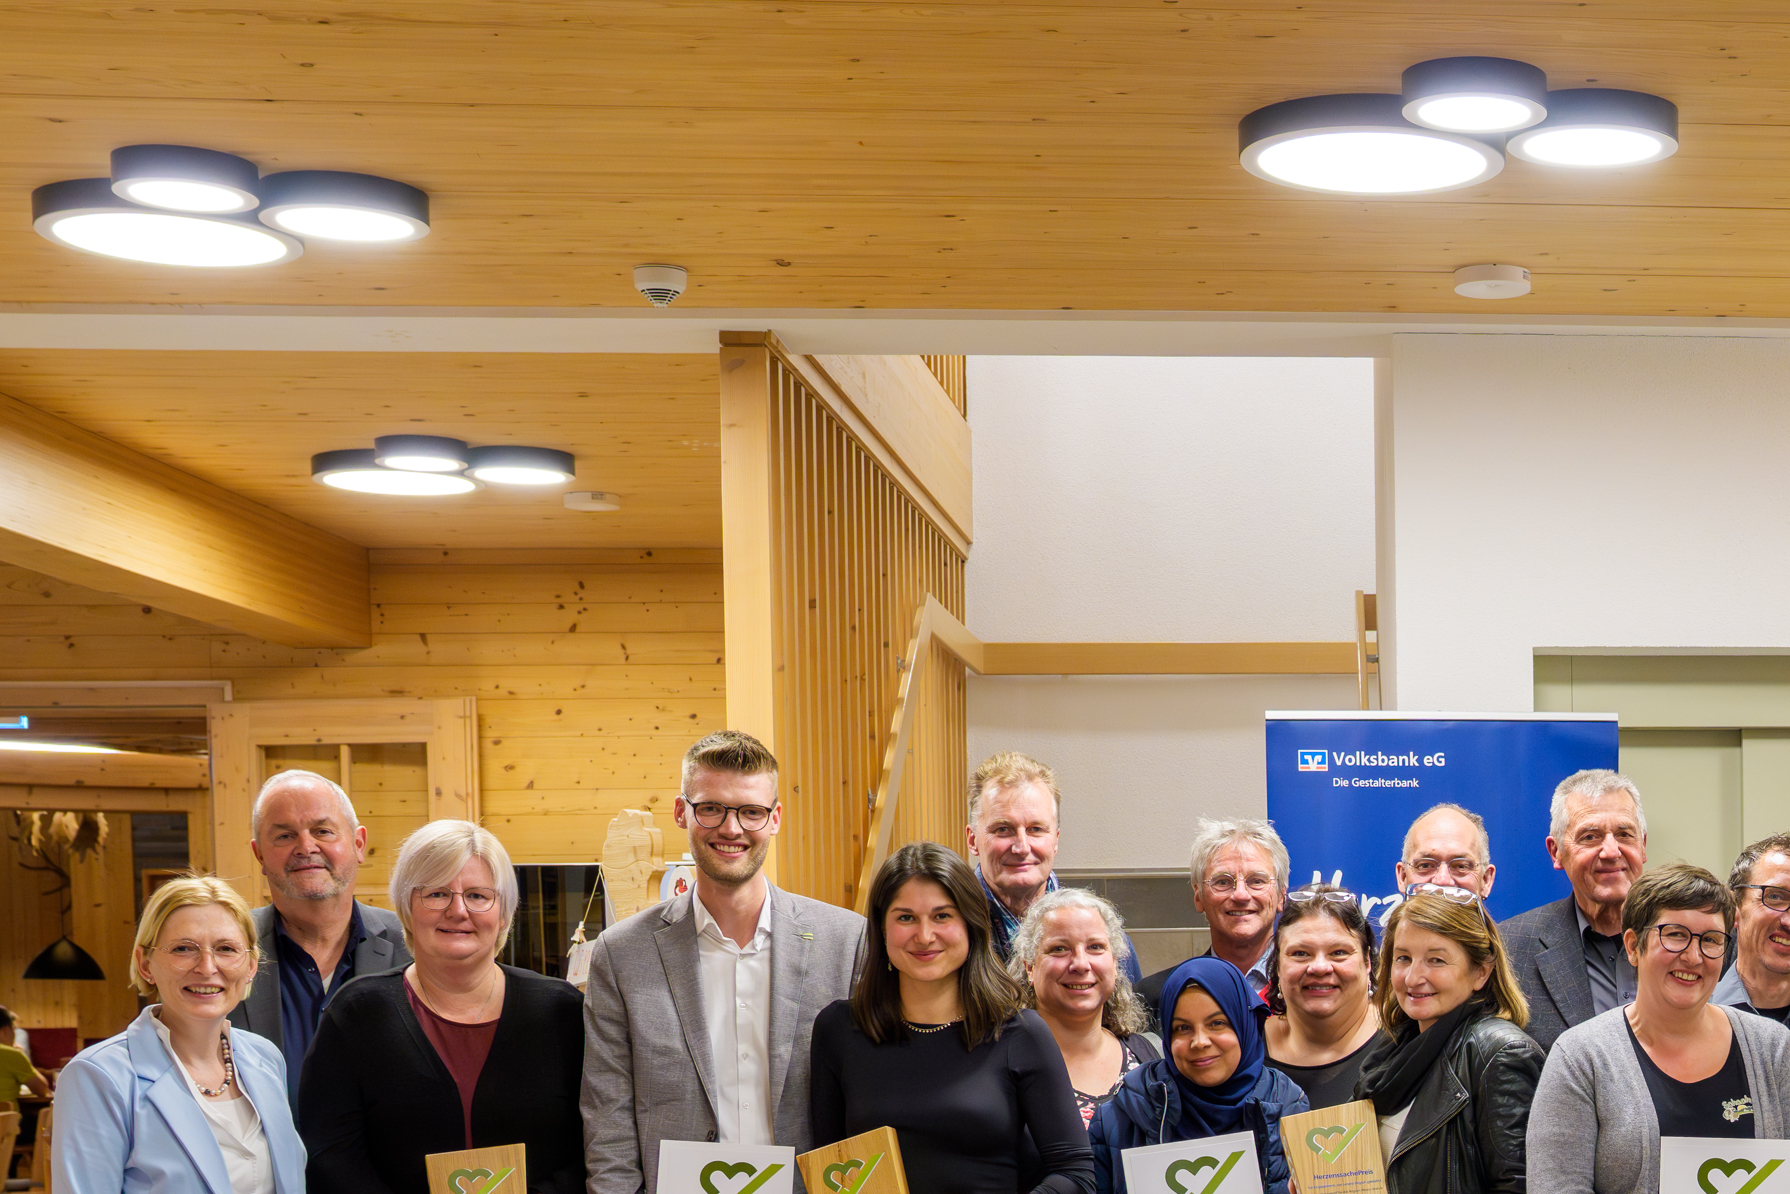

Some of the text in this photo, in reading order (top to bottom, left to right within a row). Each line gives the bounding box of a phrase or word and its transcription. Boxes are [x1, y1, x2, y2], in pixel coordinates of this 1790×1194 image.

[1332, 751, 1446, 767] Volksbank eG
[1332, 777, 1419, 788] Die Gestalterbank
[1313, 1169, 1374, 1180] HerzenssachePreis
